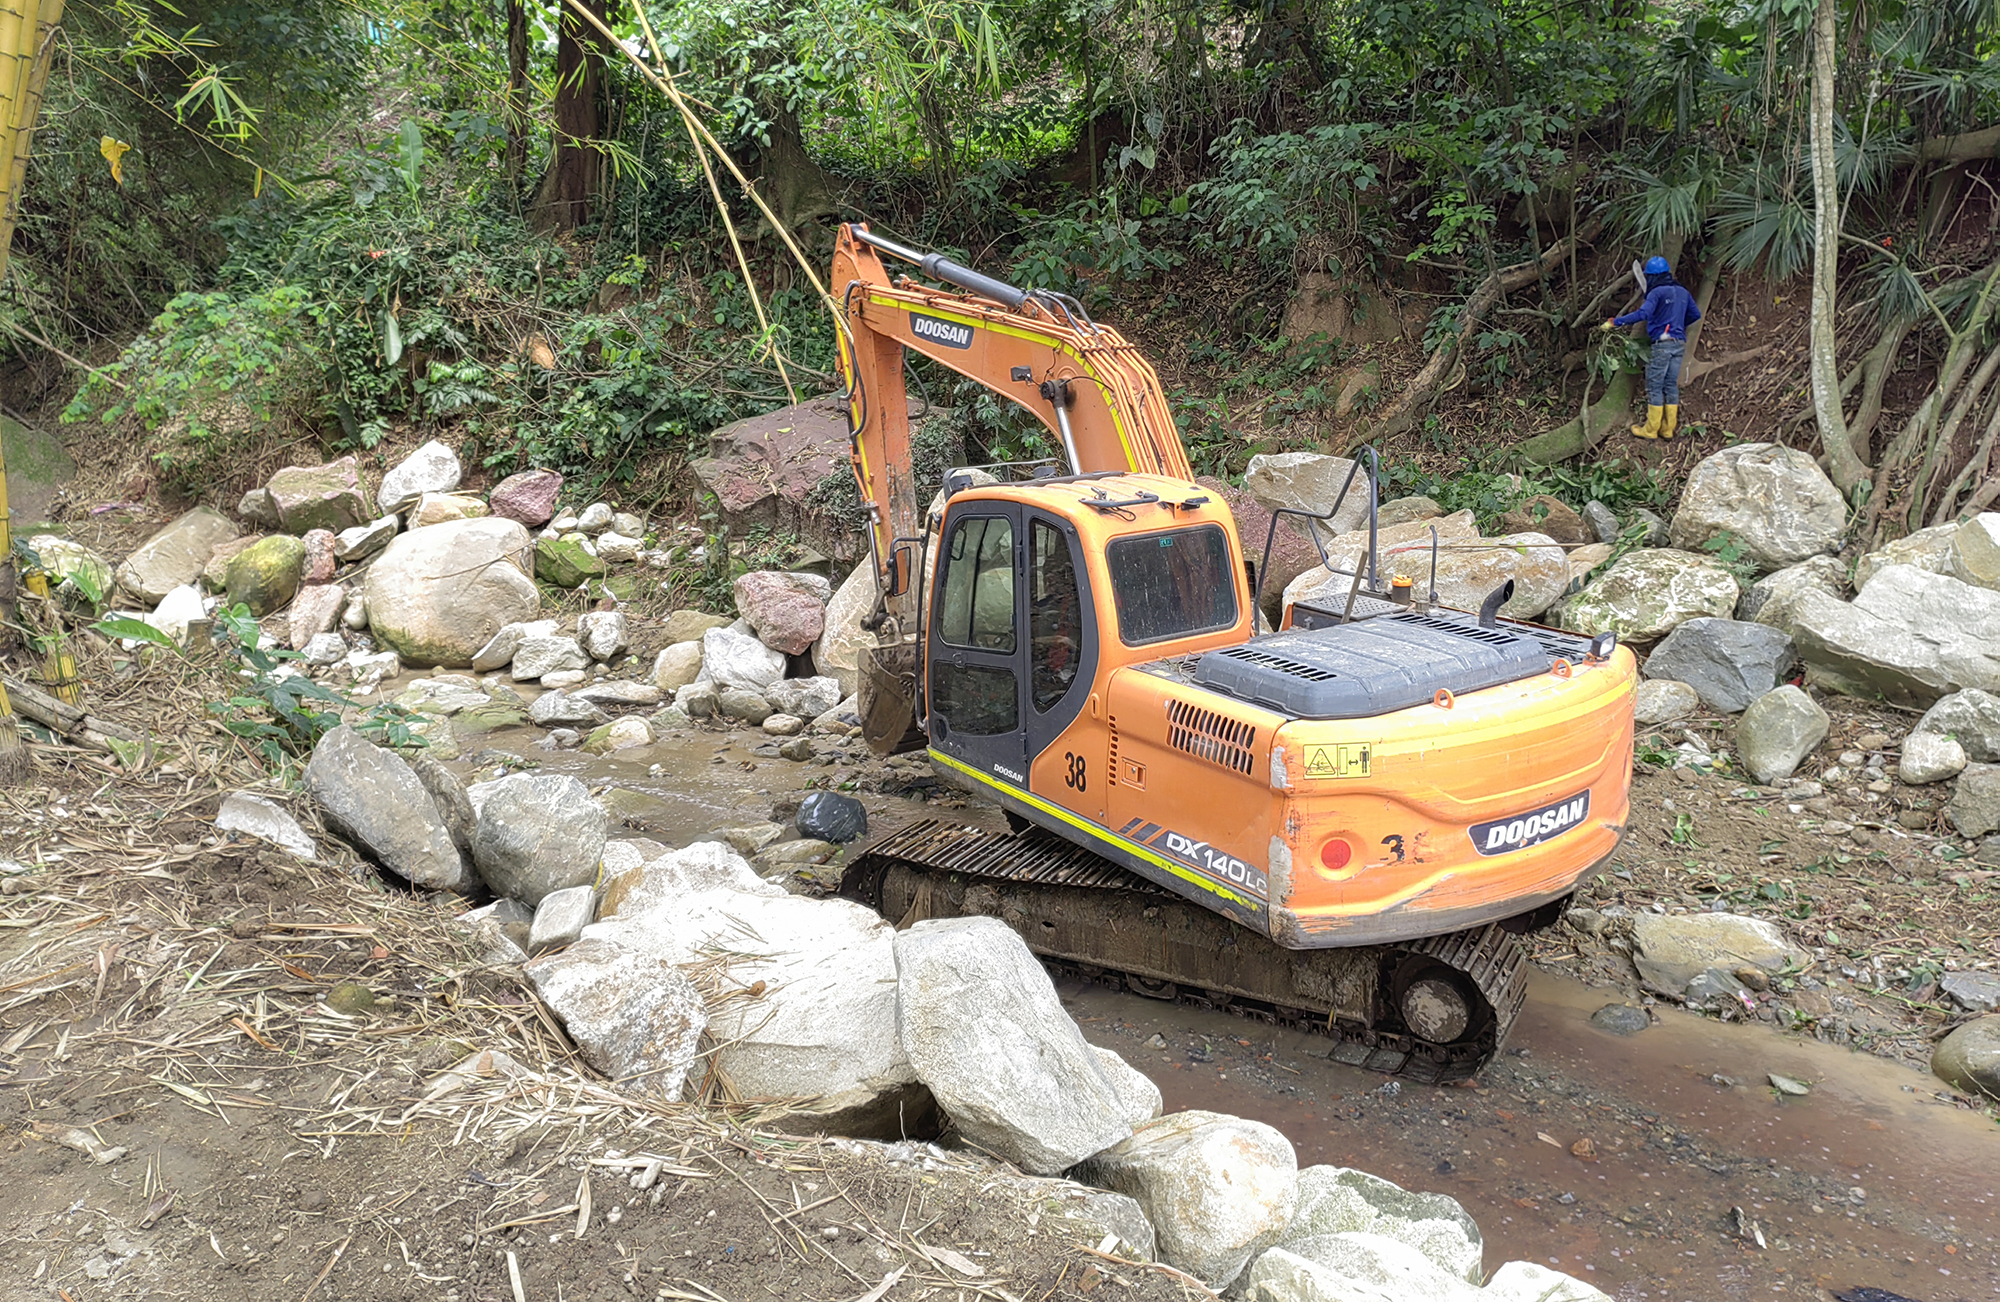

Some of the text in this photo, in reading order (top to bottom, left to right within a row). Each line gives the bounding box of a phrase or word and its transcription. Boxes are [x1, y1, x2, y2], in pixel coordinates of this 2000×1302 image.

[914, 317, 969, 345] DOOSAN
[993, 763, 1023, 783] DOOSAN
[1064, 751, 1087, 793] 38
[1485, 797, 1584, 849] DOOSAN
